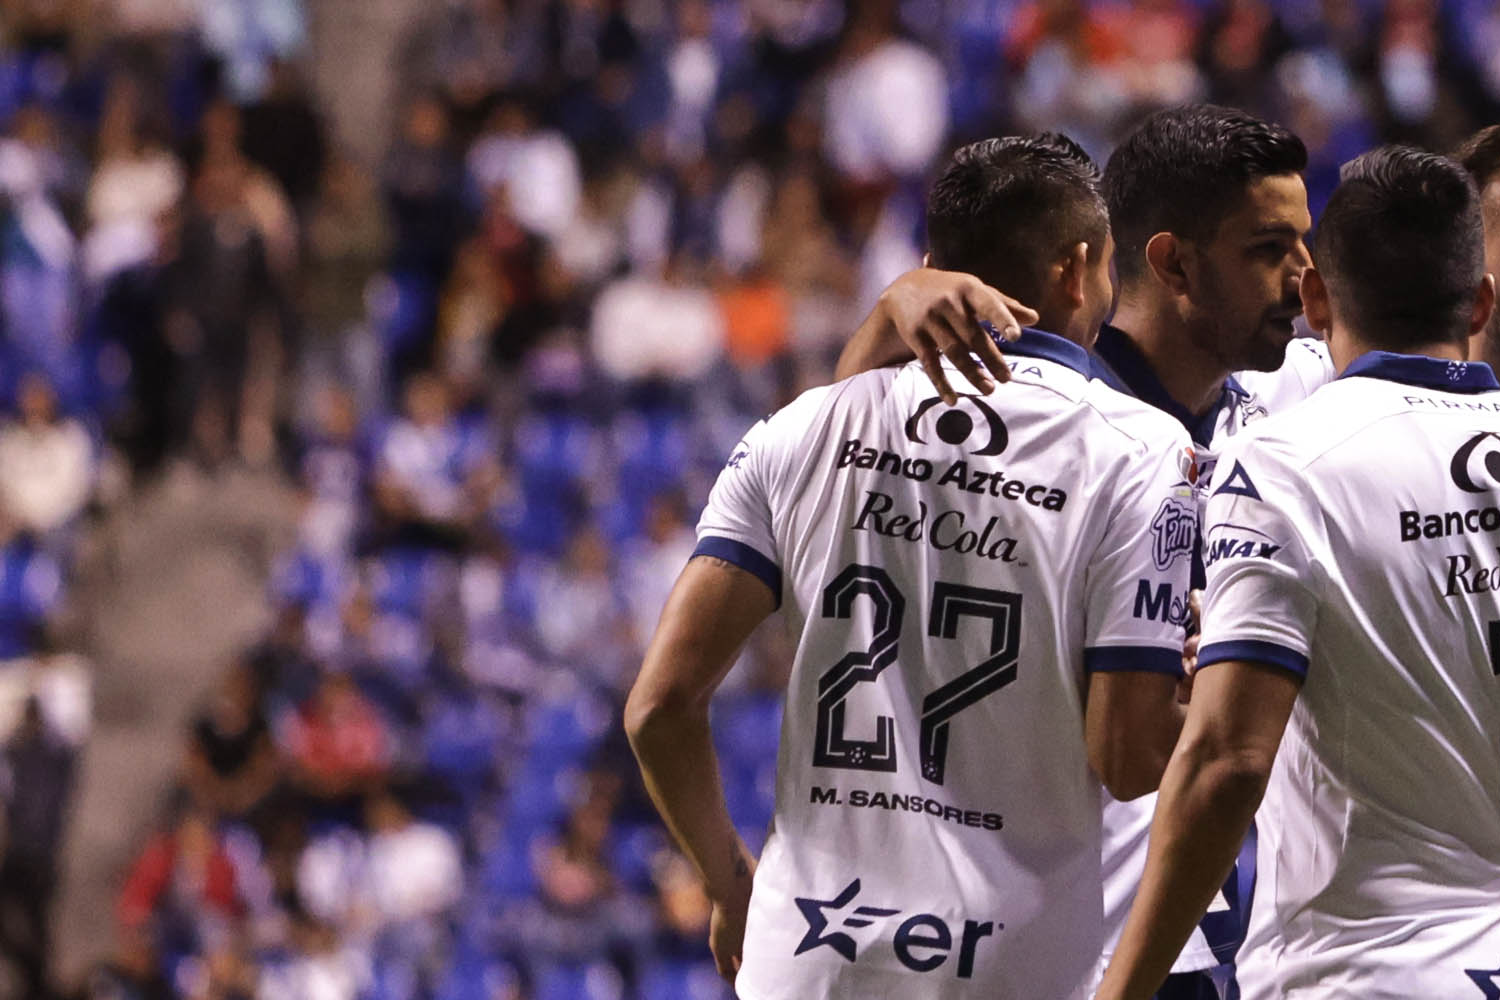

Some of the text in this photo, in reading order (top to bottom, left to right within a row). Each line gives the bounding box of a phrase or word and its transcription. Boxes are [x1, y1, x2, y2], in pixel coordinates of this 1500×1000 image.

[837, 439, 1068, 513] Banco Azteca
[852, 491, 1021, 563] Red Cola
[1206, 538, 1281, 568] ANAX
[1400, 507, 1500, 542] Banco
[812, 562, 1023, 786] 27
[809, 786, 1004, 831] M. SANSORES
[893, 913, 994, 979] er
